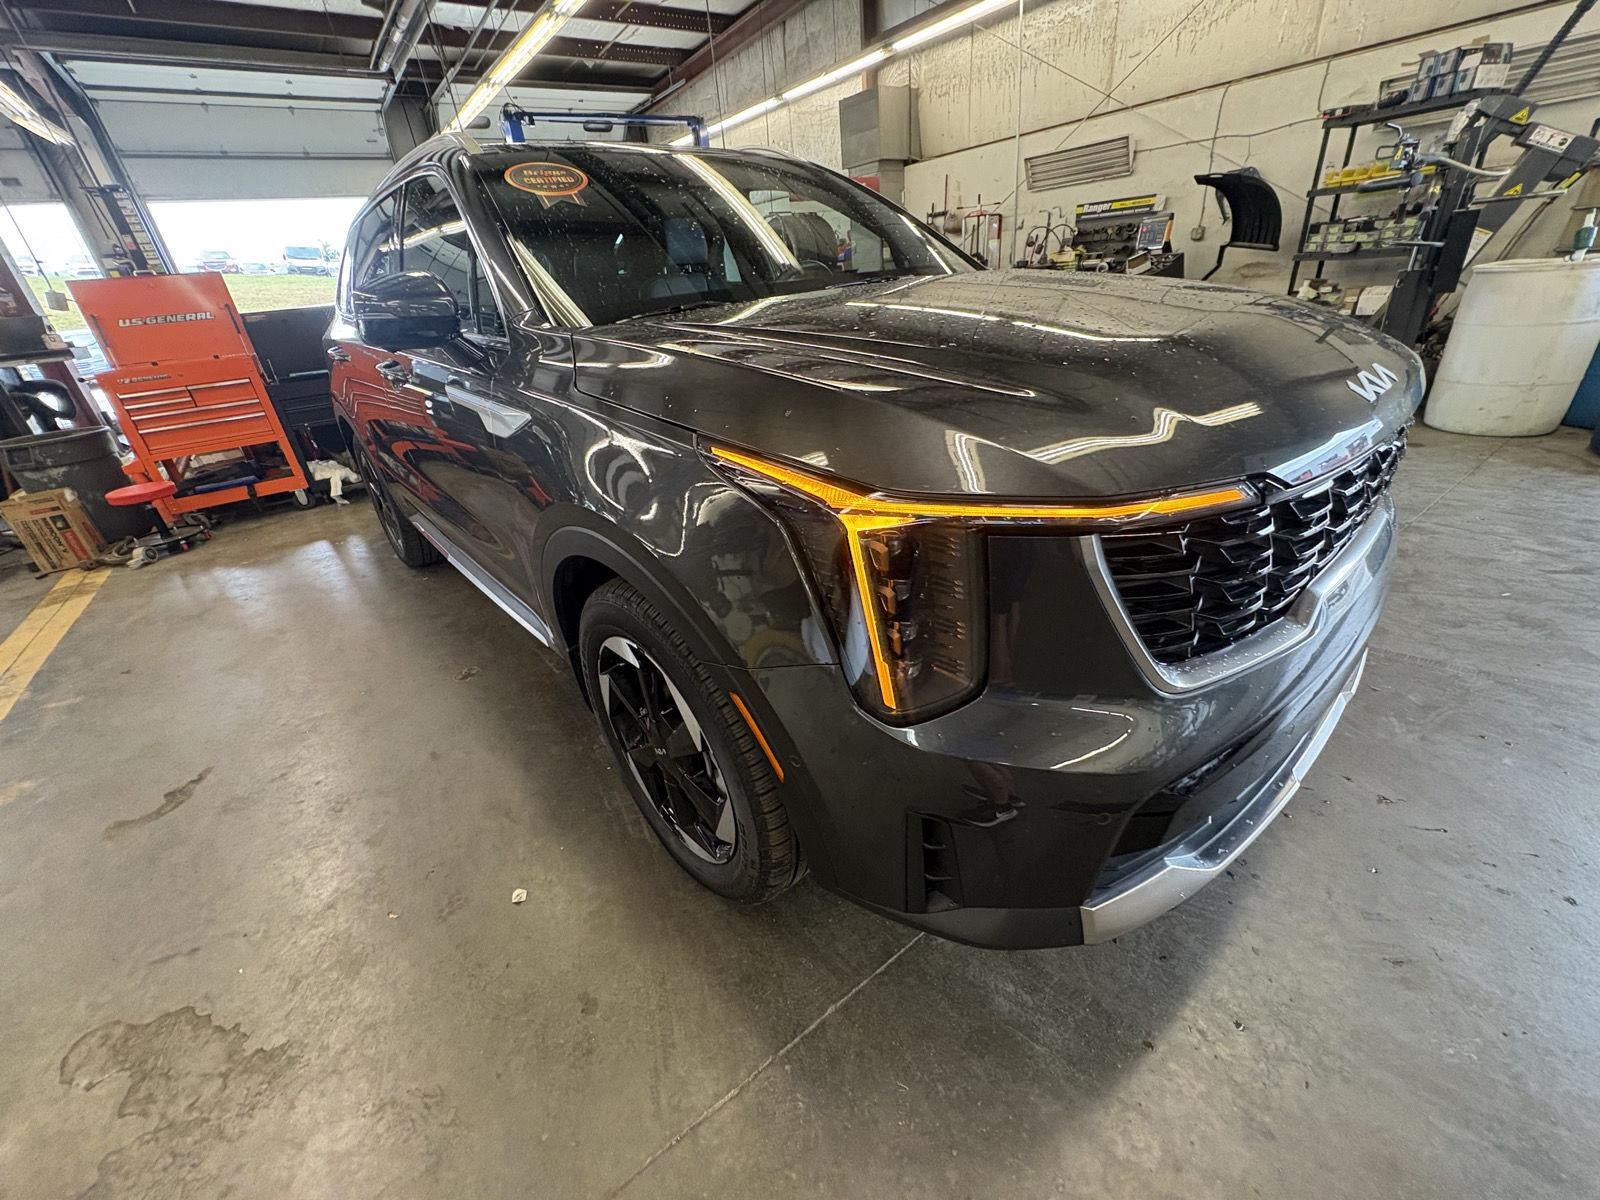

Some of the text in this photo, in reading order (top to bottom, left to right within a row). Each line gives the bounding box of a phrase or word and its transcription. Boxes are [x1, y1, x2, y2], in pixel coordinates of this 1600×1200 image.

[523, 176, 575, 184] CERTIFIED
[1082, 203, 1112, 213] Ranger
[145, 311, 215, 325] GENERAL
